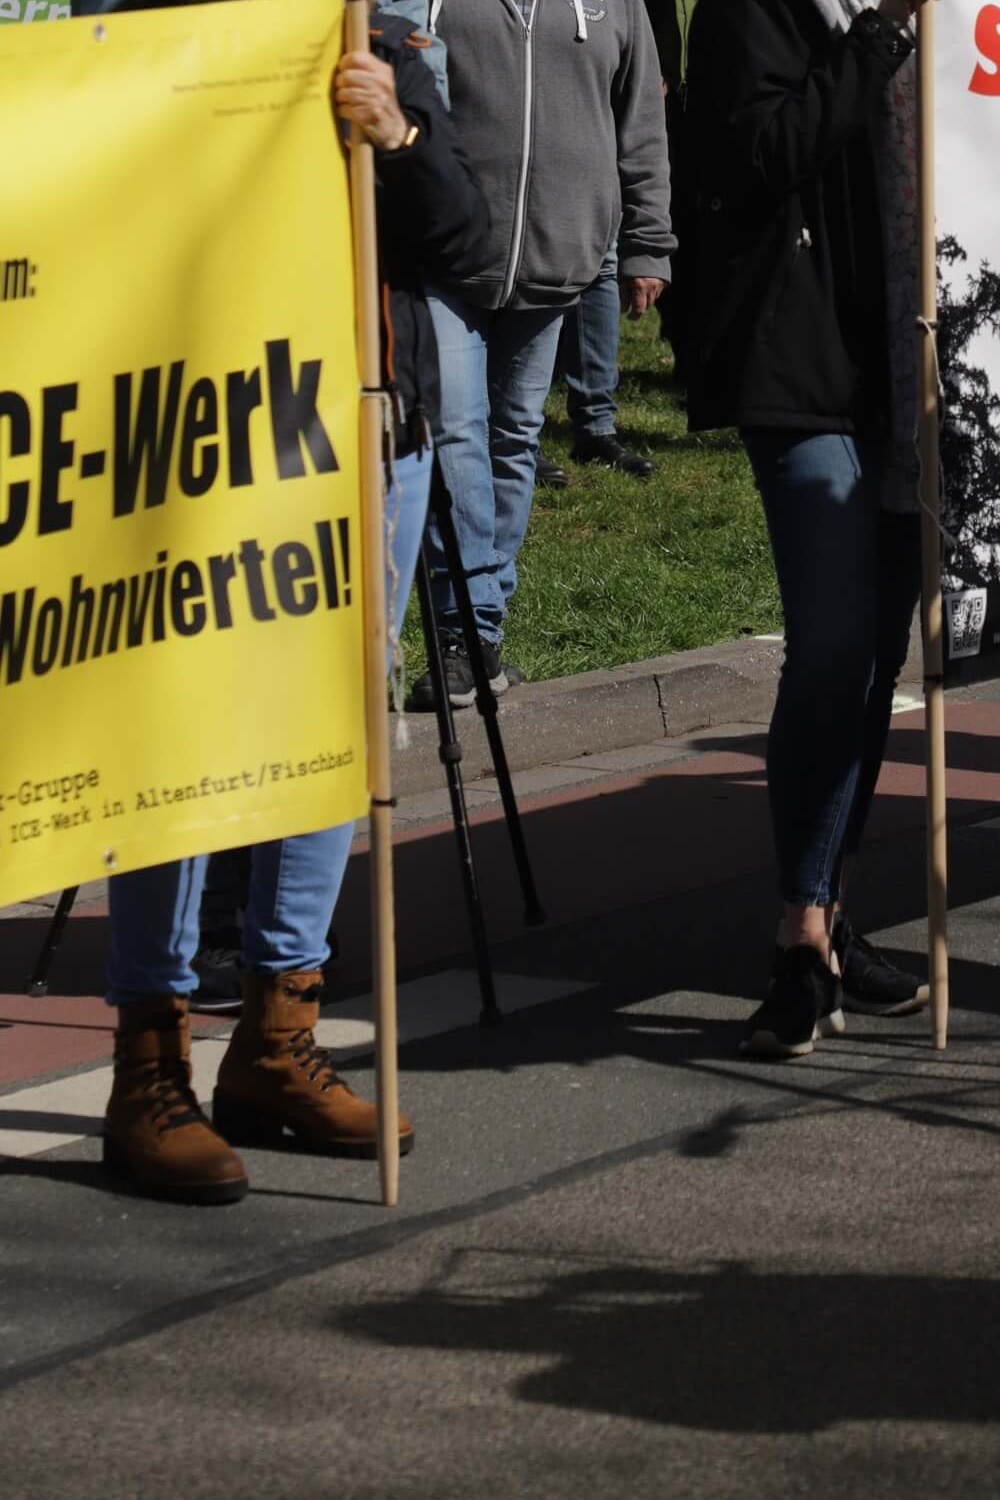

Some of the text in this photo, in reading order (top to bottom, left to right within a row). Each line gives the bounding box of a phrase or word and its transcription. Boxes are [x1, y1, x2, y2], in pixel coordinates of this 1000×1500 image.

[0, 769, 99, 812] -Gruppe
[11, 806, 91, 844] ICE-Werk
[102, 800, 125, 818] in
